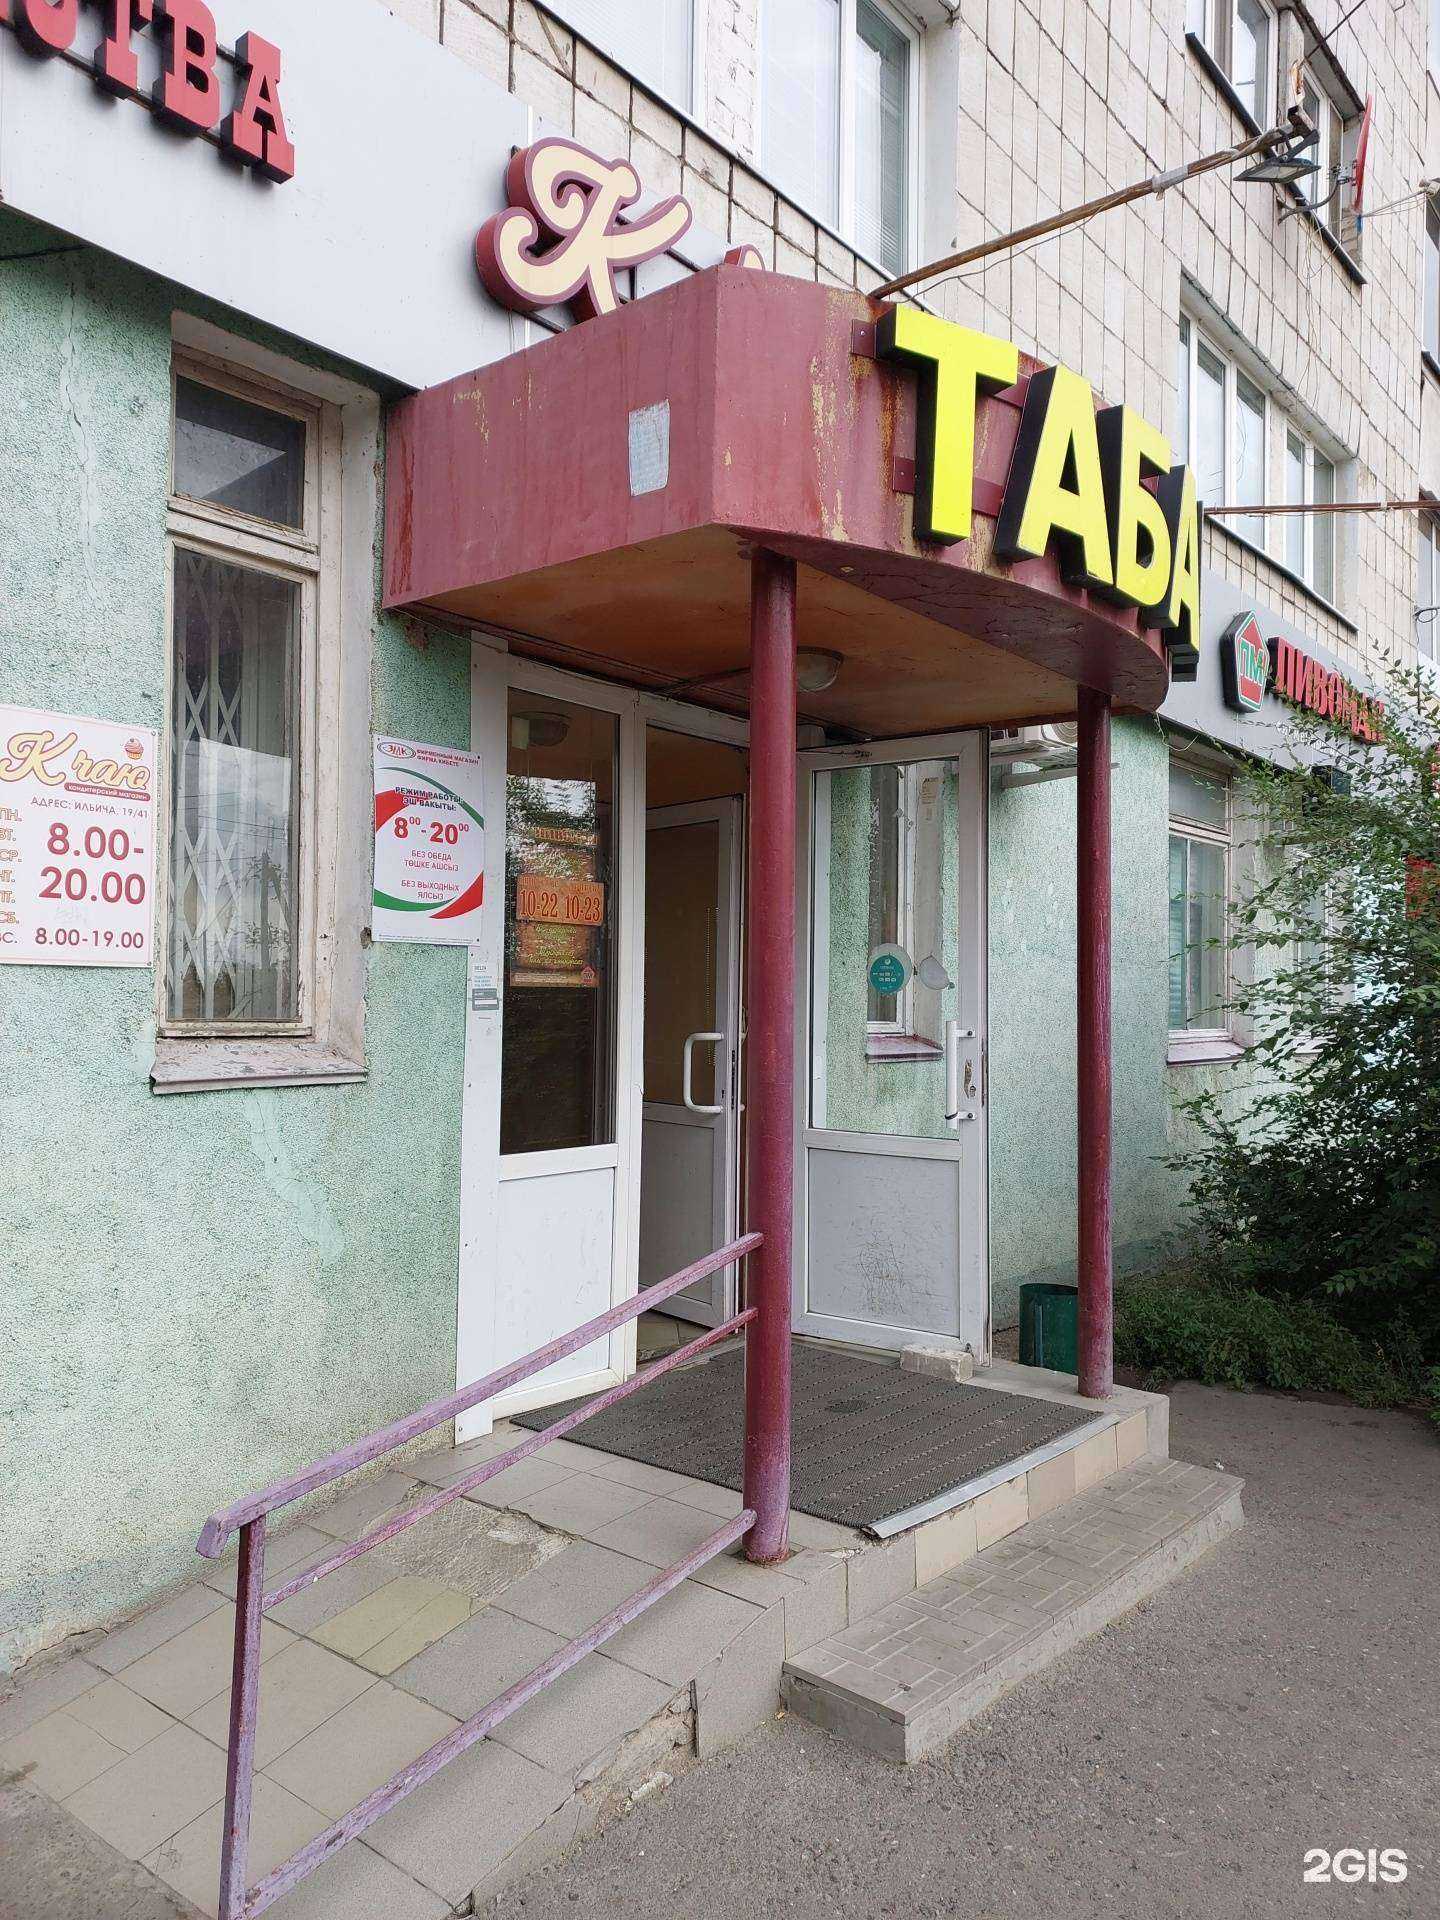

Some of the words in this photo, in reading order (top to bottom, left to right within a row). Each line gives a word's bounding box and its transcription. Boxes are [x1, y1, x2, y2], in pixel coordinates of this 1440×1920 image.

[0, 0, 294, 178] ТВА
[68, 784, 118, 797] кондитерский
[395, 786, 427, 798] РЕЖИМ
[31, 796, 71, 809] АДРЕС:
[122, 807, 148, 819] 19/41
[402, 796, 417, 806] ЭШ
[419, 799, 457, 812] ВАКЫТЫ:
[47, 822, 144, 861] 8.00-
[411, 849, 426, 858] БЕЗ
[427, 851, 452, 861] ОБЕДА
[38, 866, 146, 905] 20.00
[401, 879, 416, 888] БЕЗ
[417, 881, 460, 892] ВЫХОДНЫХ
[417, 891, 444, 900] ЯЛСЫЗ
[521, 889, 558, 918] 10-22
[564, 894, 601, 922] 10-23
[0, 931, 18, 944] С.
[34, 927, 144, 948] 8.00-19.00
